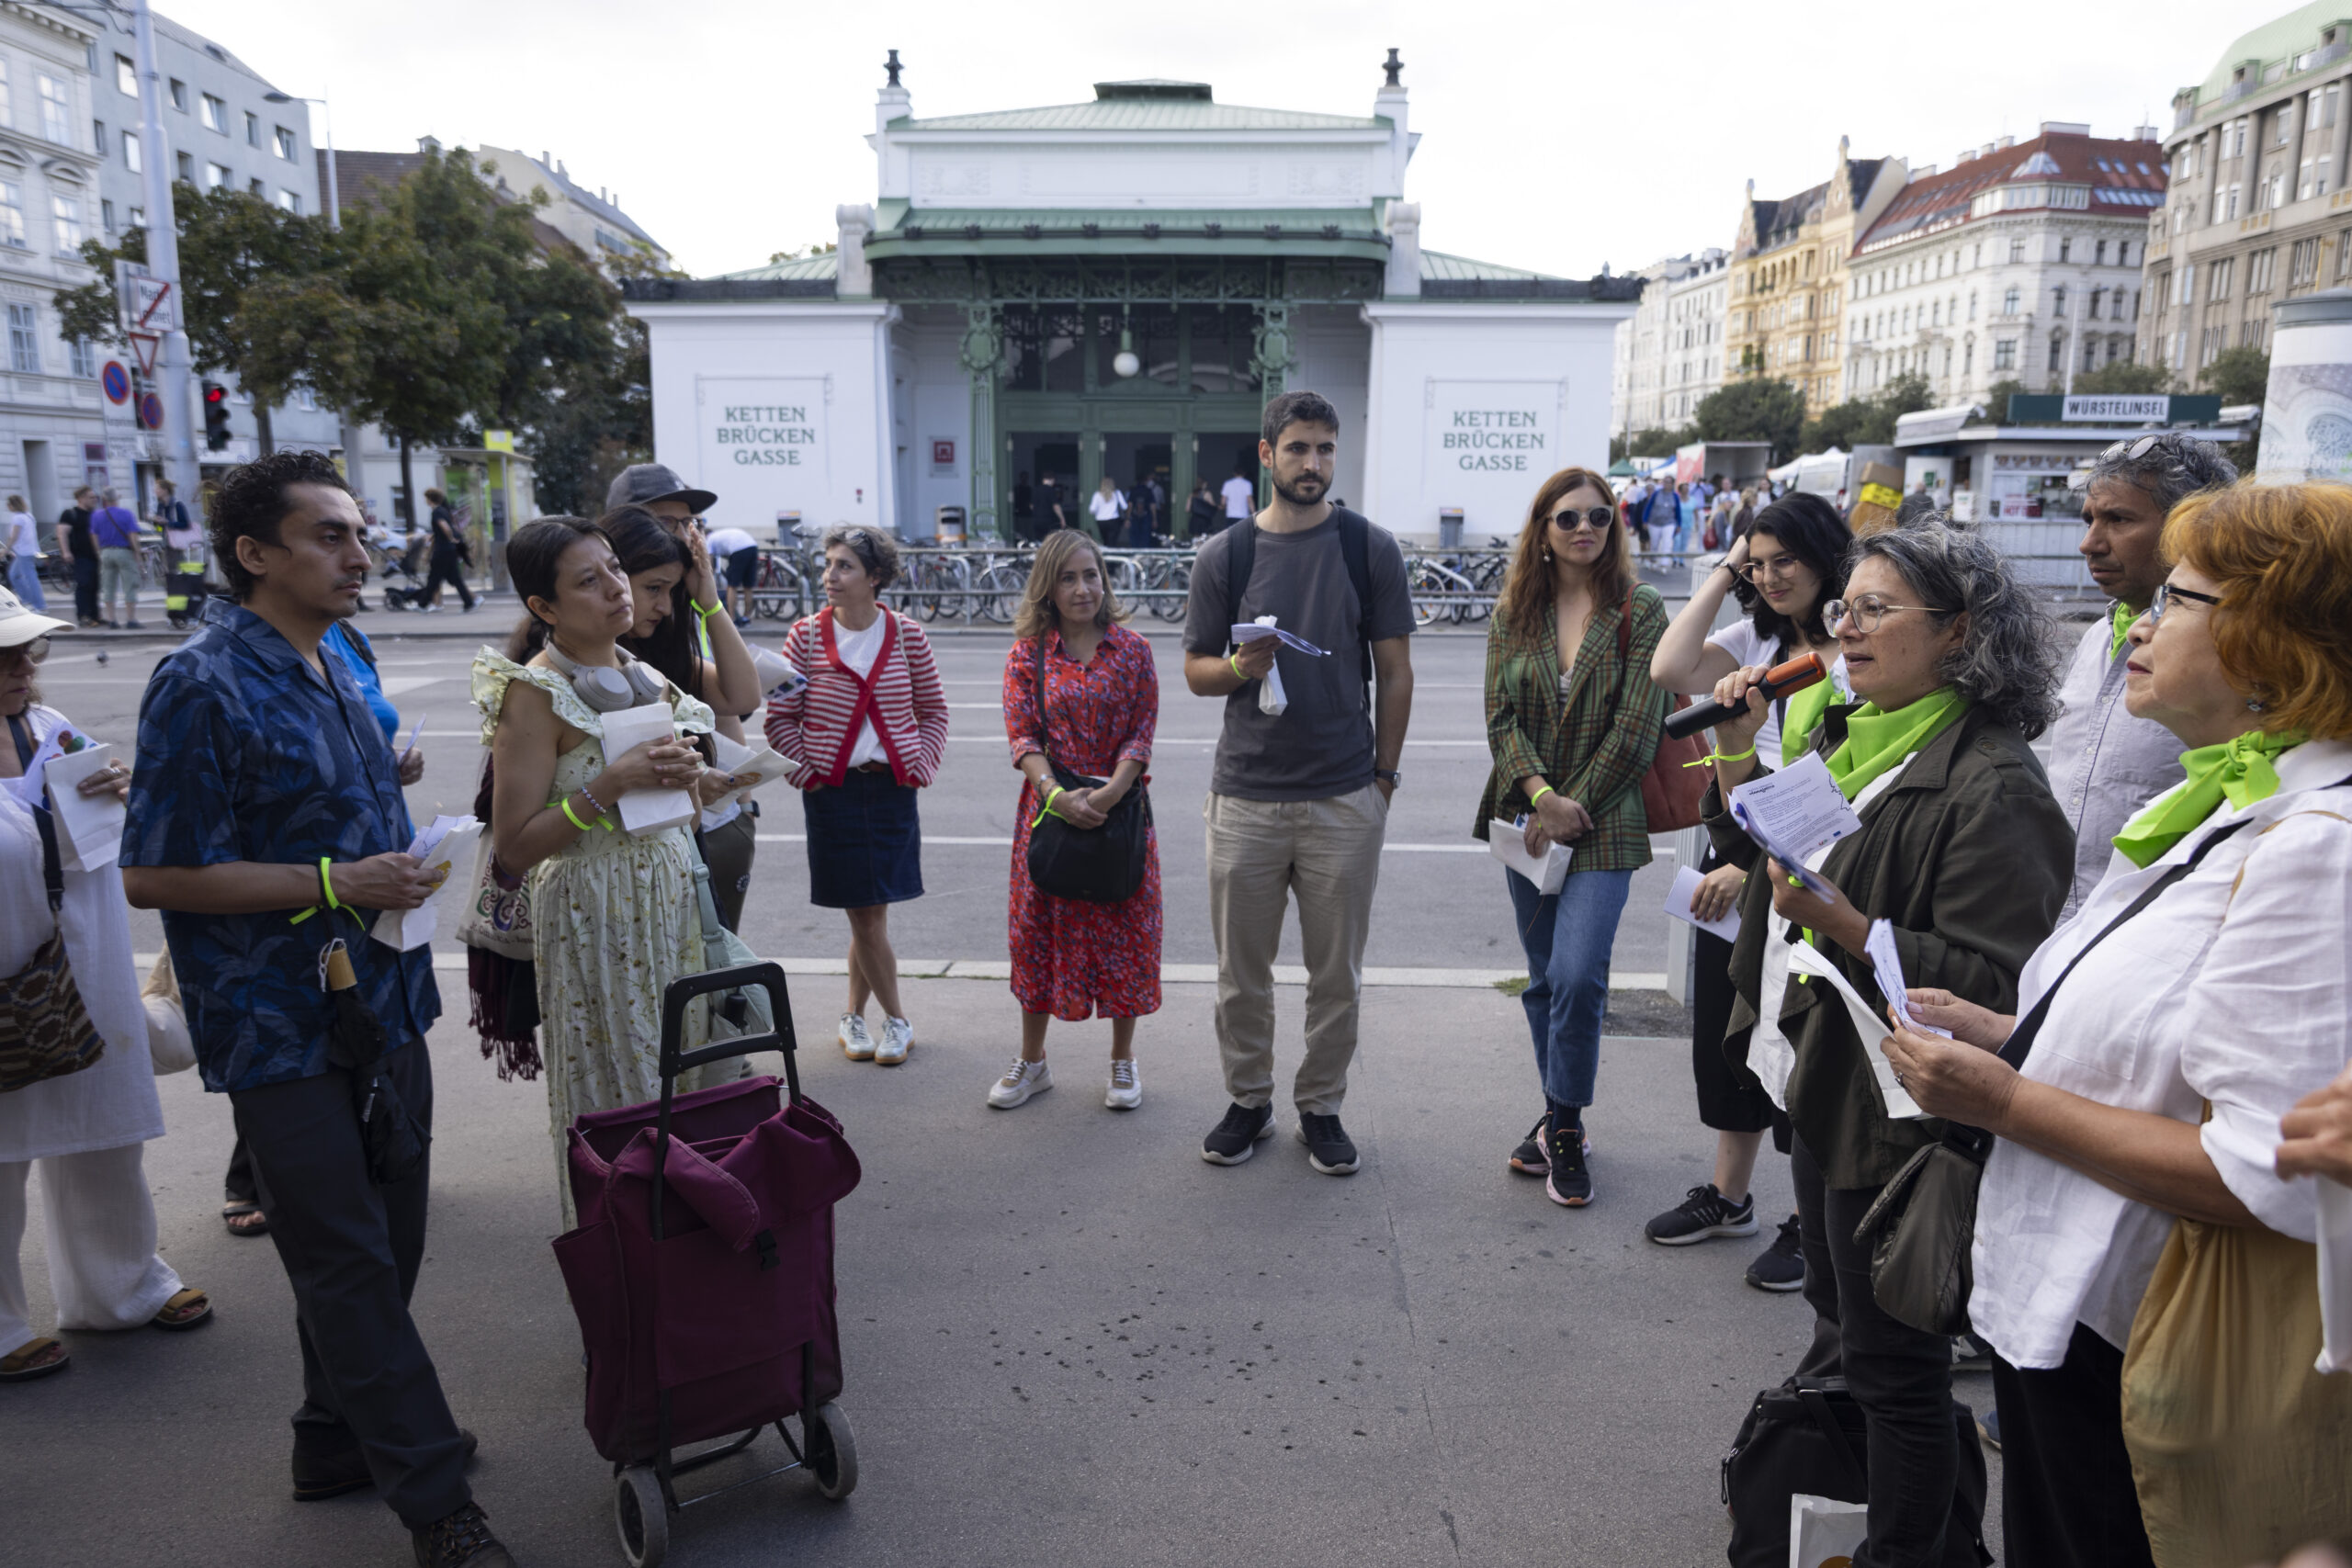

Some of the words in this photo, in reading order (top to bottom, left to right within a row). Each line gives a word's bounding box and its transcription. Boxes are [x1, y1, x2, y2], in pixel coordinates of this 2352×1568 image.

[725, 406, 806, 423] KETTEN
[2068, 399, 2165, 416] WÜRSTELINSEL
[1453, 411, 1537, 427] KETTEN
[717, 424, 815, 444] BRÜCKEN
[1443, 429, 1544, 449] BRÜCKEN
[733, 449, 802, 466] GASSE
[1458, 455, 1528, 471] GASSE
